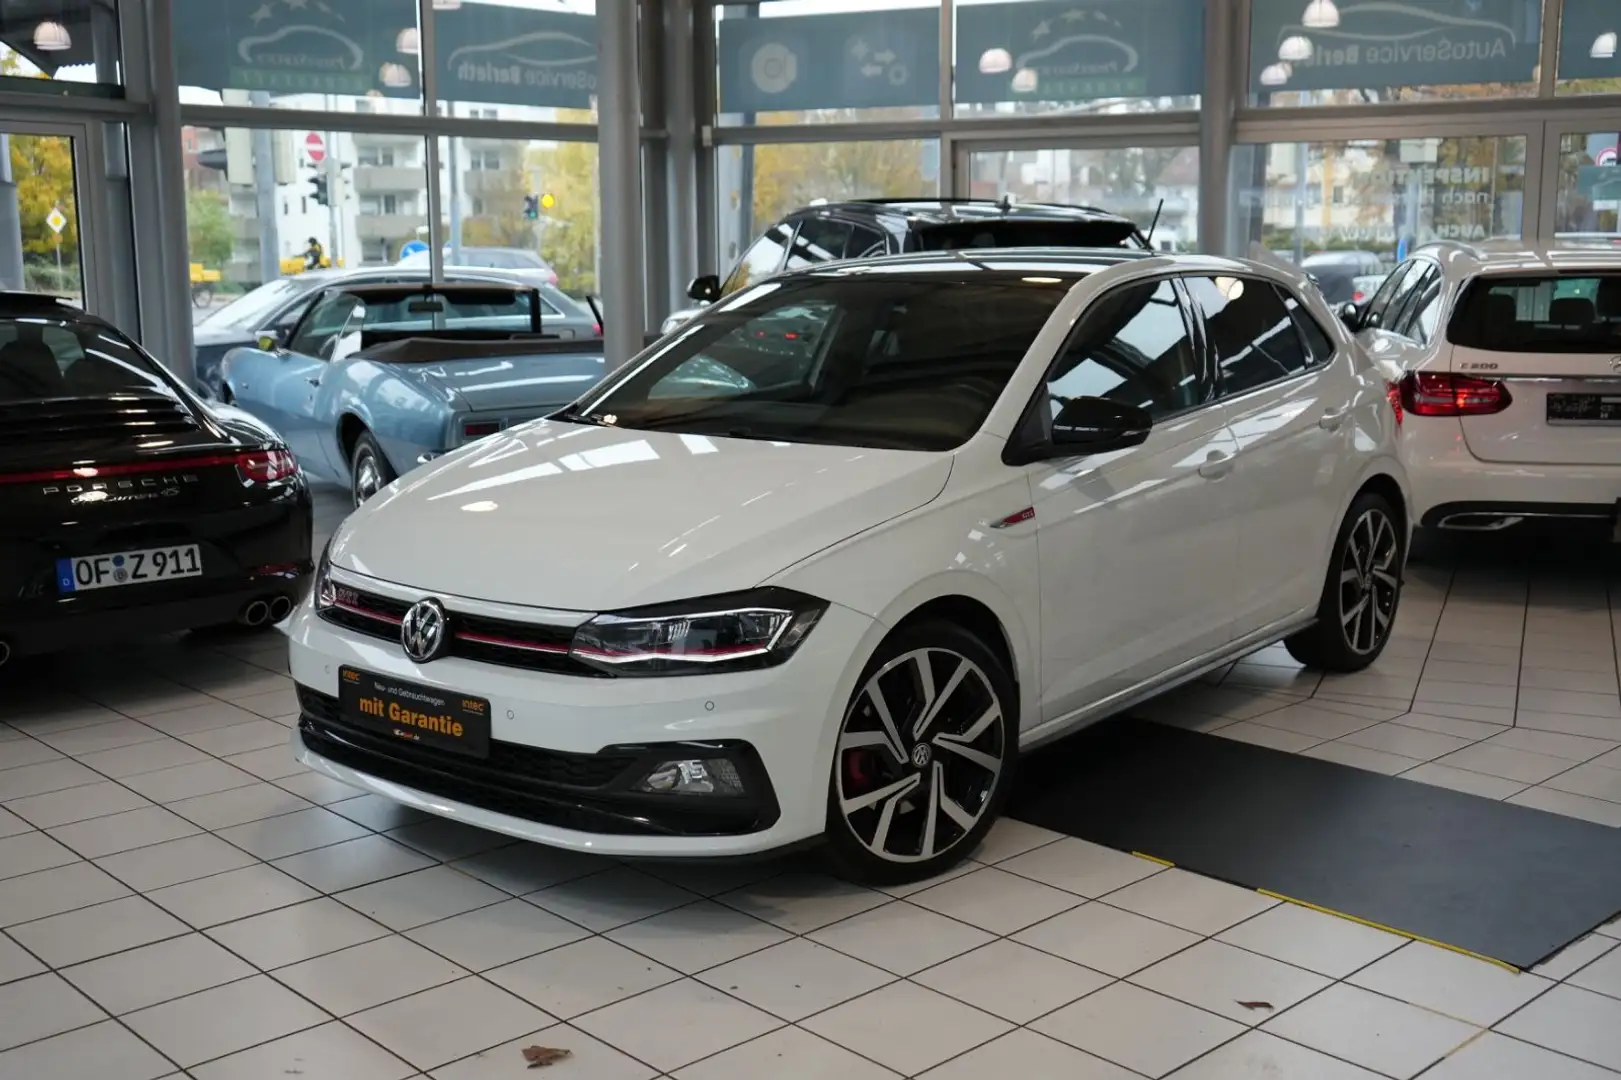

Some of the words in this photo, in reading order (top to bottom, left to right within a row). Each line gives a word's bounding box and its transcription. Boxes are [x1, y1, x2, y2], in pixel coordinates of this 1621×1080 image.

[43, 475, 198, 494] PORSCHE
[75, 557, 110, 585] OF
[129, 554, 148, 579] Z
[152, 547, 200, 577] 911
[398, 687, 446, 707] Gebrauchtwagen
[359, 697, 385, 718] mit
[388, 702, 464, 737] Garantie
